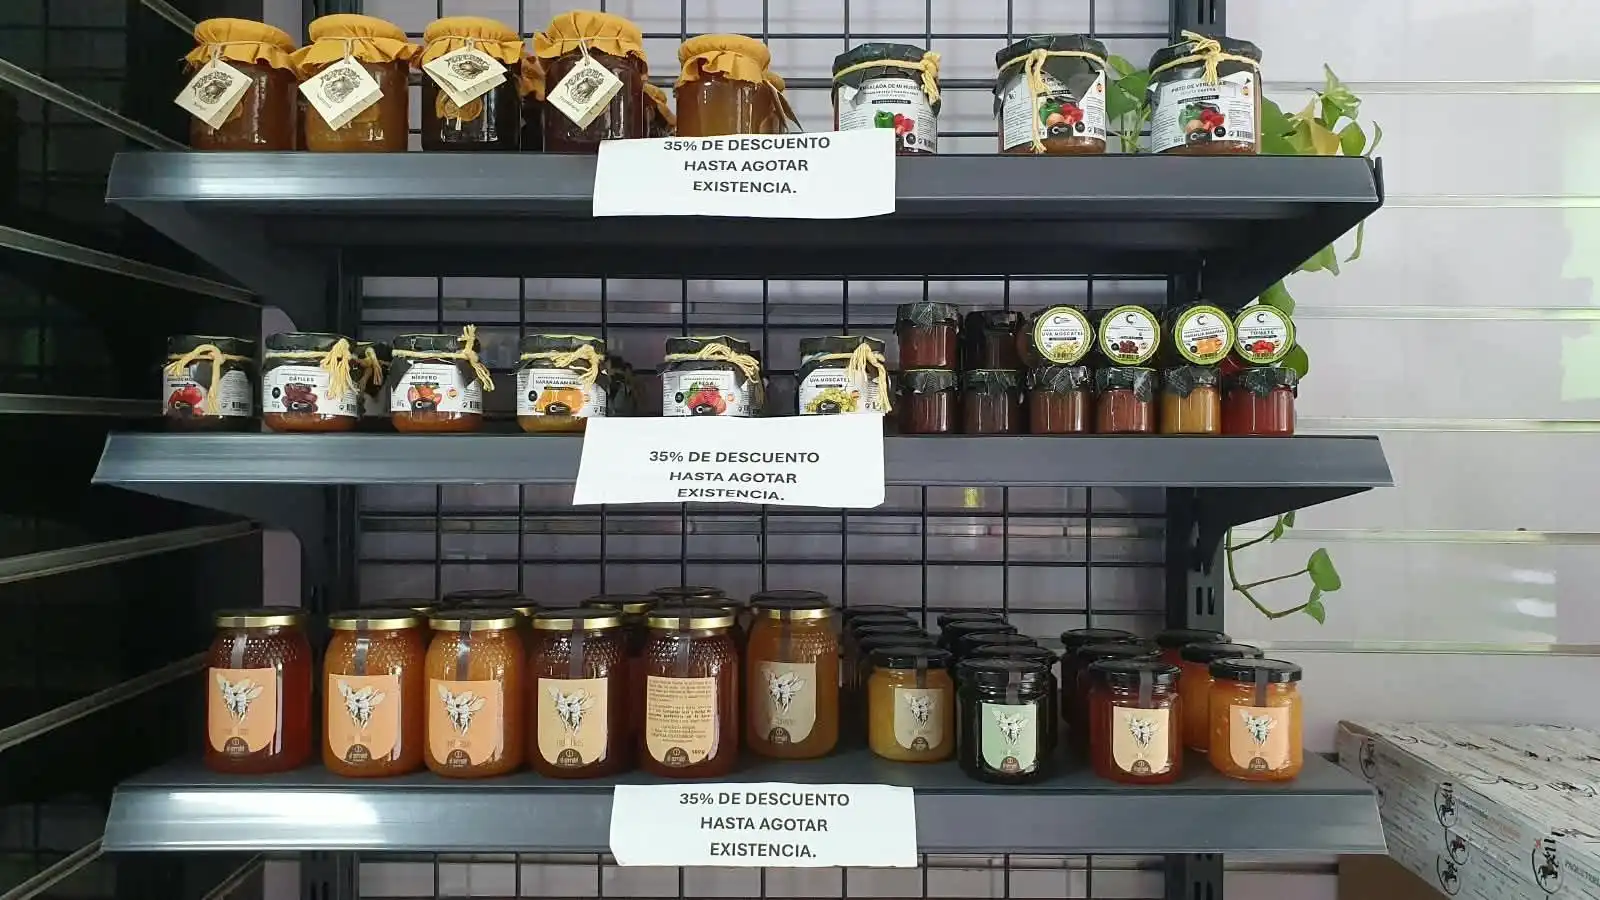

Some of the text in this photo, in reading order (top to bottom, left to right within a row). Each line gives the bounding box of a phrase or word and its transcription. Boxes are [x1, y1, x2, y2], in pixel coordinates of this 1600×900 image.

[664, 136, 830, 151] 35% DE DESCUENTO
[684, 160, 808, 171] HASTA AGOTAR
[693, 180, 797, 194] EXISTENCIA.
[649, 451, 820, 463] 35% DE DESCUENTO
[670, 472, 797, 484] HASTA AGOTAR
[677, 488, 785, 500] EXISTENCIA.
[679, 793, 850, 806] 35% DE DESCUENTO
[701, 817, 828, 831] HASTA AGOTAR
[710, 842, 817, 858] EXISTENCIA.
